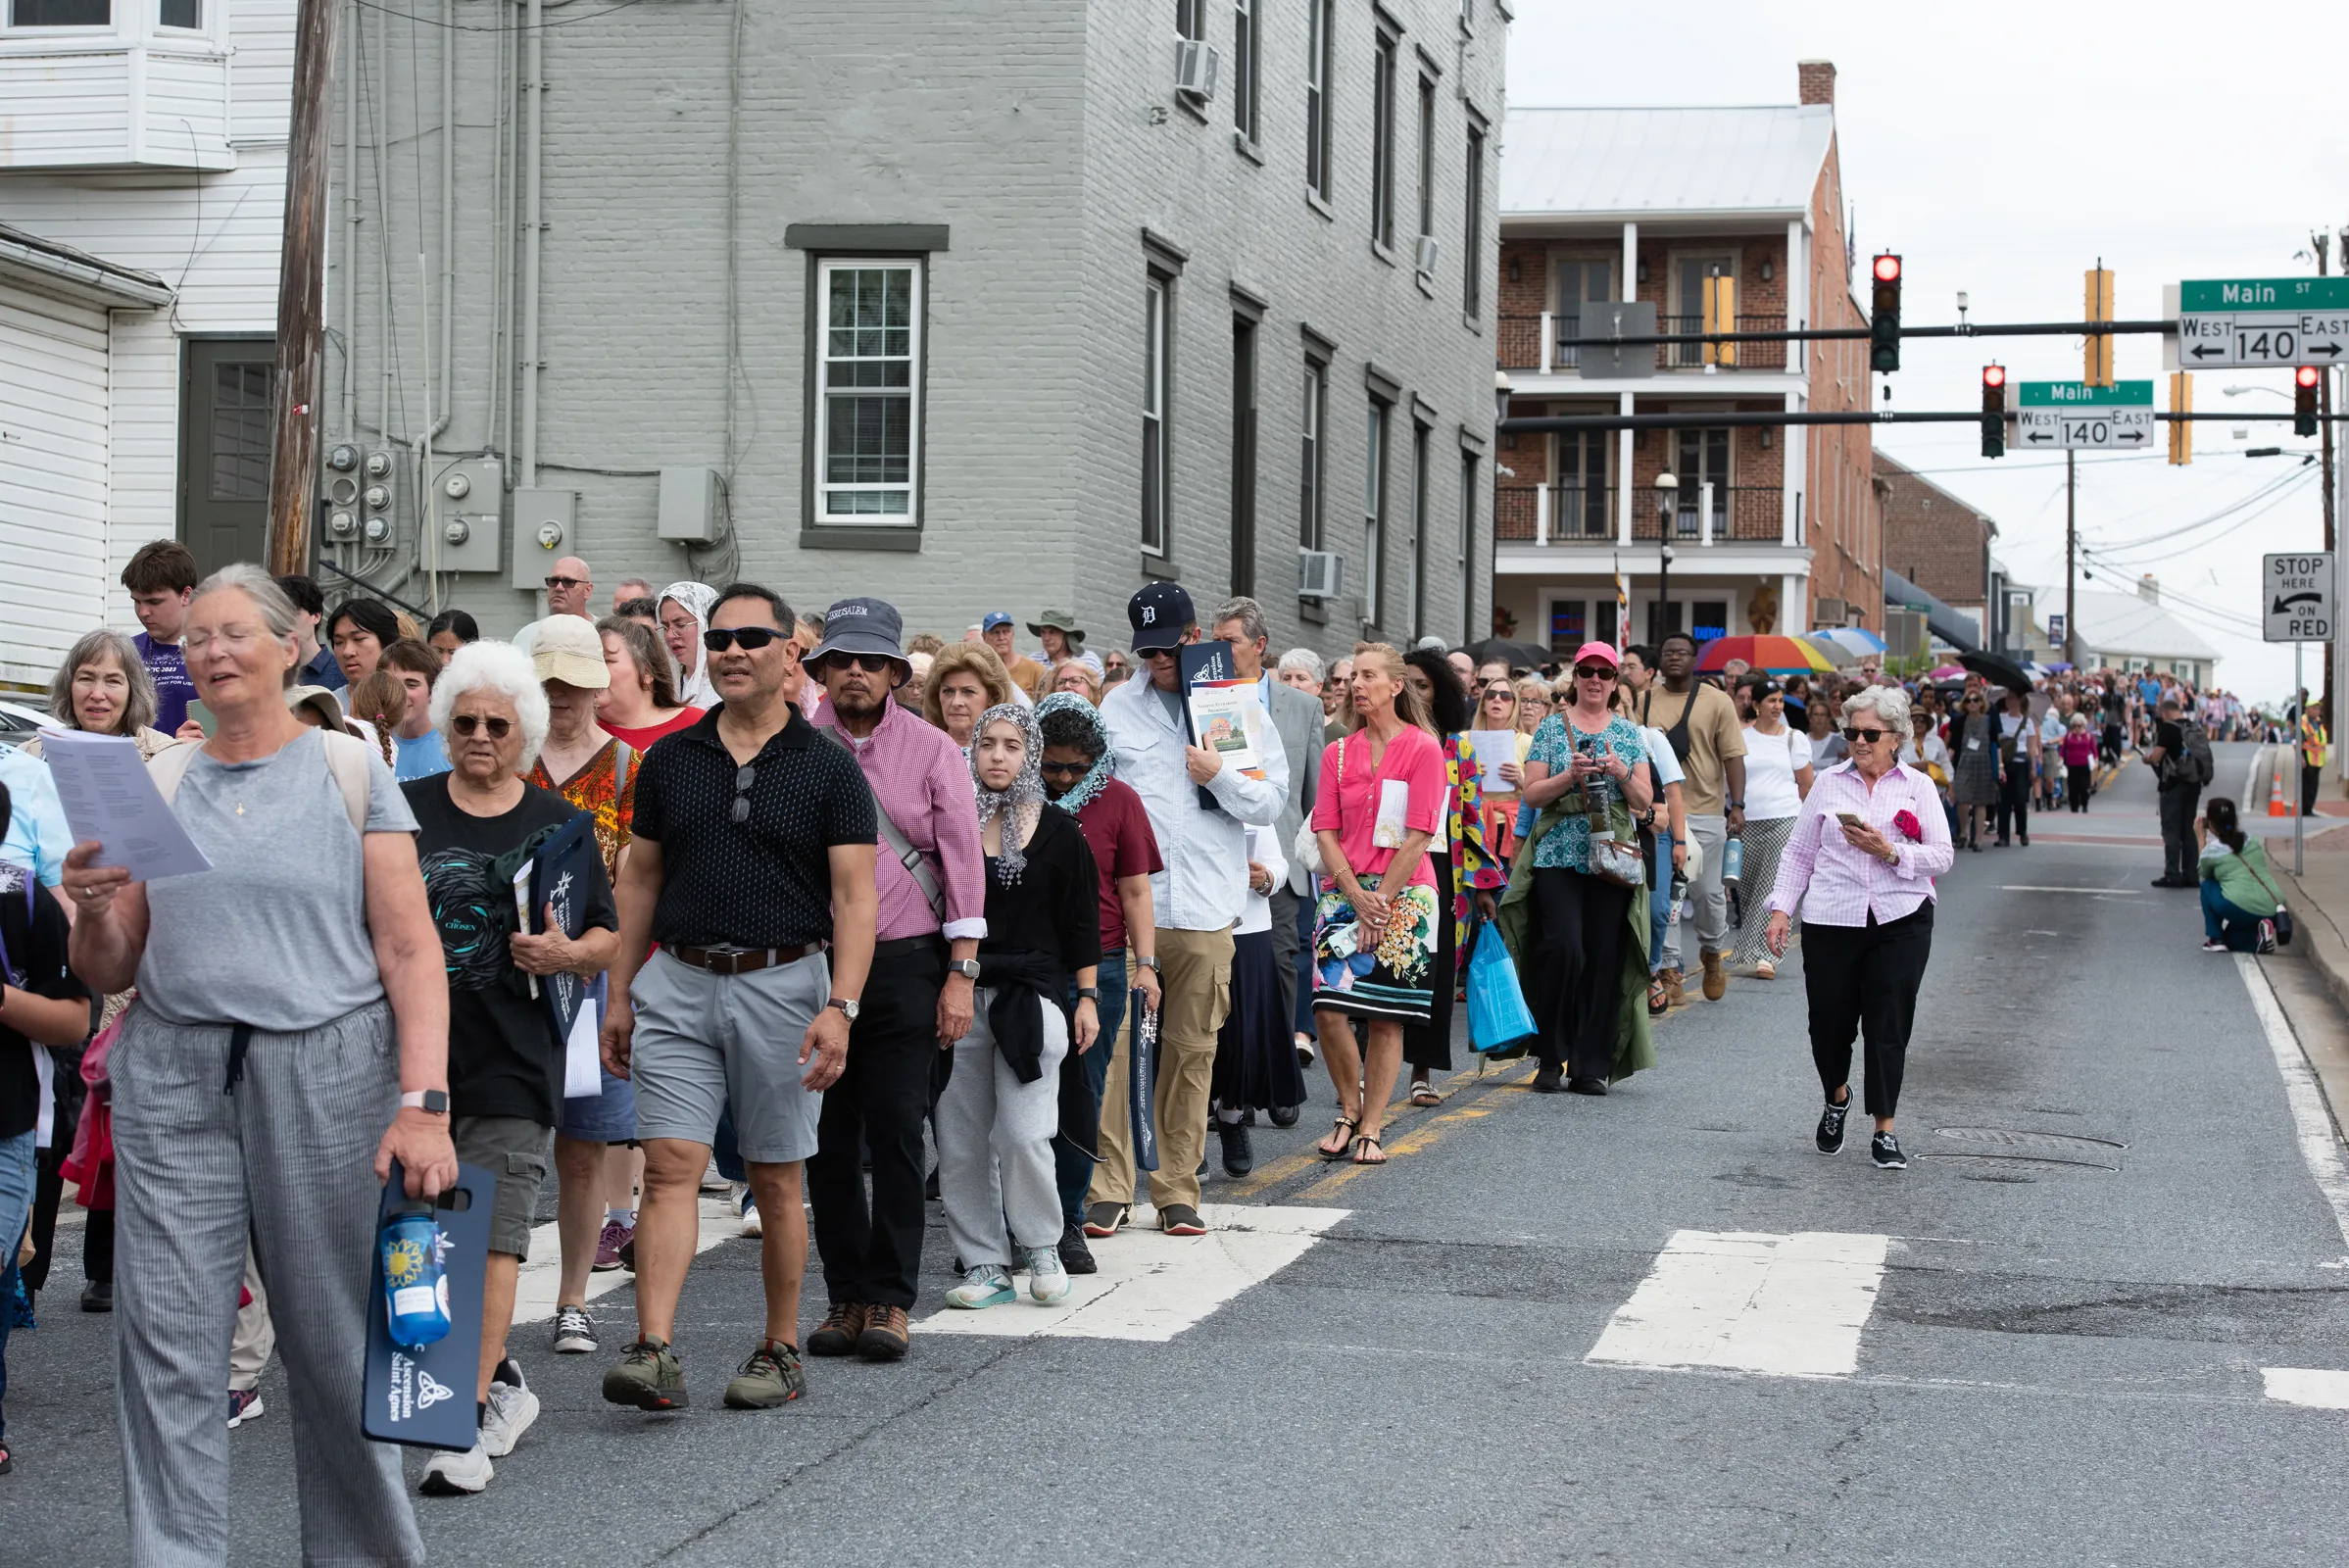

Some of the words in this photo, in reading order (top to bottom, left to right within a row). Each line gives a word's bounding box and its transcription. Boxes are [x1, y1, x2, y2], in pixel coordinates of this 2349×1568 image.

[2223, 283, 2276, 304] Main
[2295, 282, 2311, 294] ST
[2182, 318, 2232, 337] WEST
[2238, 330, 2294, 360] 140
[2301, 316, 2349, 335] EAST
[2051, 384, 2092, 400] Main
[2021, 412, 2059, 425] WEST
[2064, 422, 2108, 444] 140
[2112, 411, 2150, 425] EAST
[2275, 558, 2324, 575] STOP
[2281, 578, 2315, 589] HERE
[827, 605, 868, 621] JERUSALEM
[2298, 606, 2316, 616] ON
[2289, 619, 2328, 636] RED
[445, 922, 476, 931] CHOSEN
[390, 1351, 404, 1385] Saint
[402, 1356, 416, 1419] Ascension
[389, 1385, 403, 1422] Agnes
